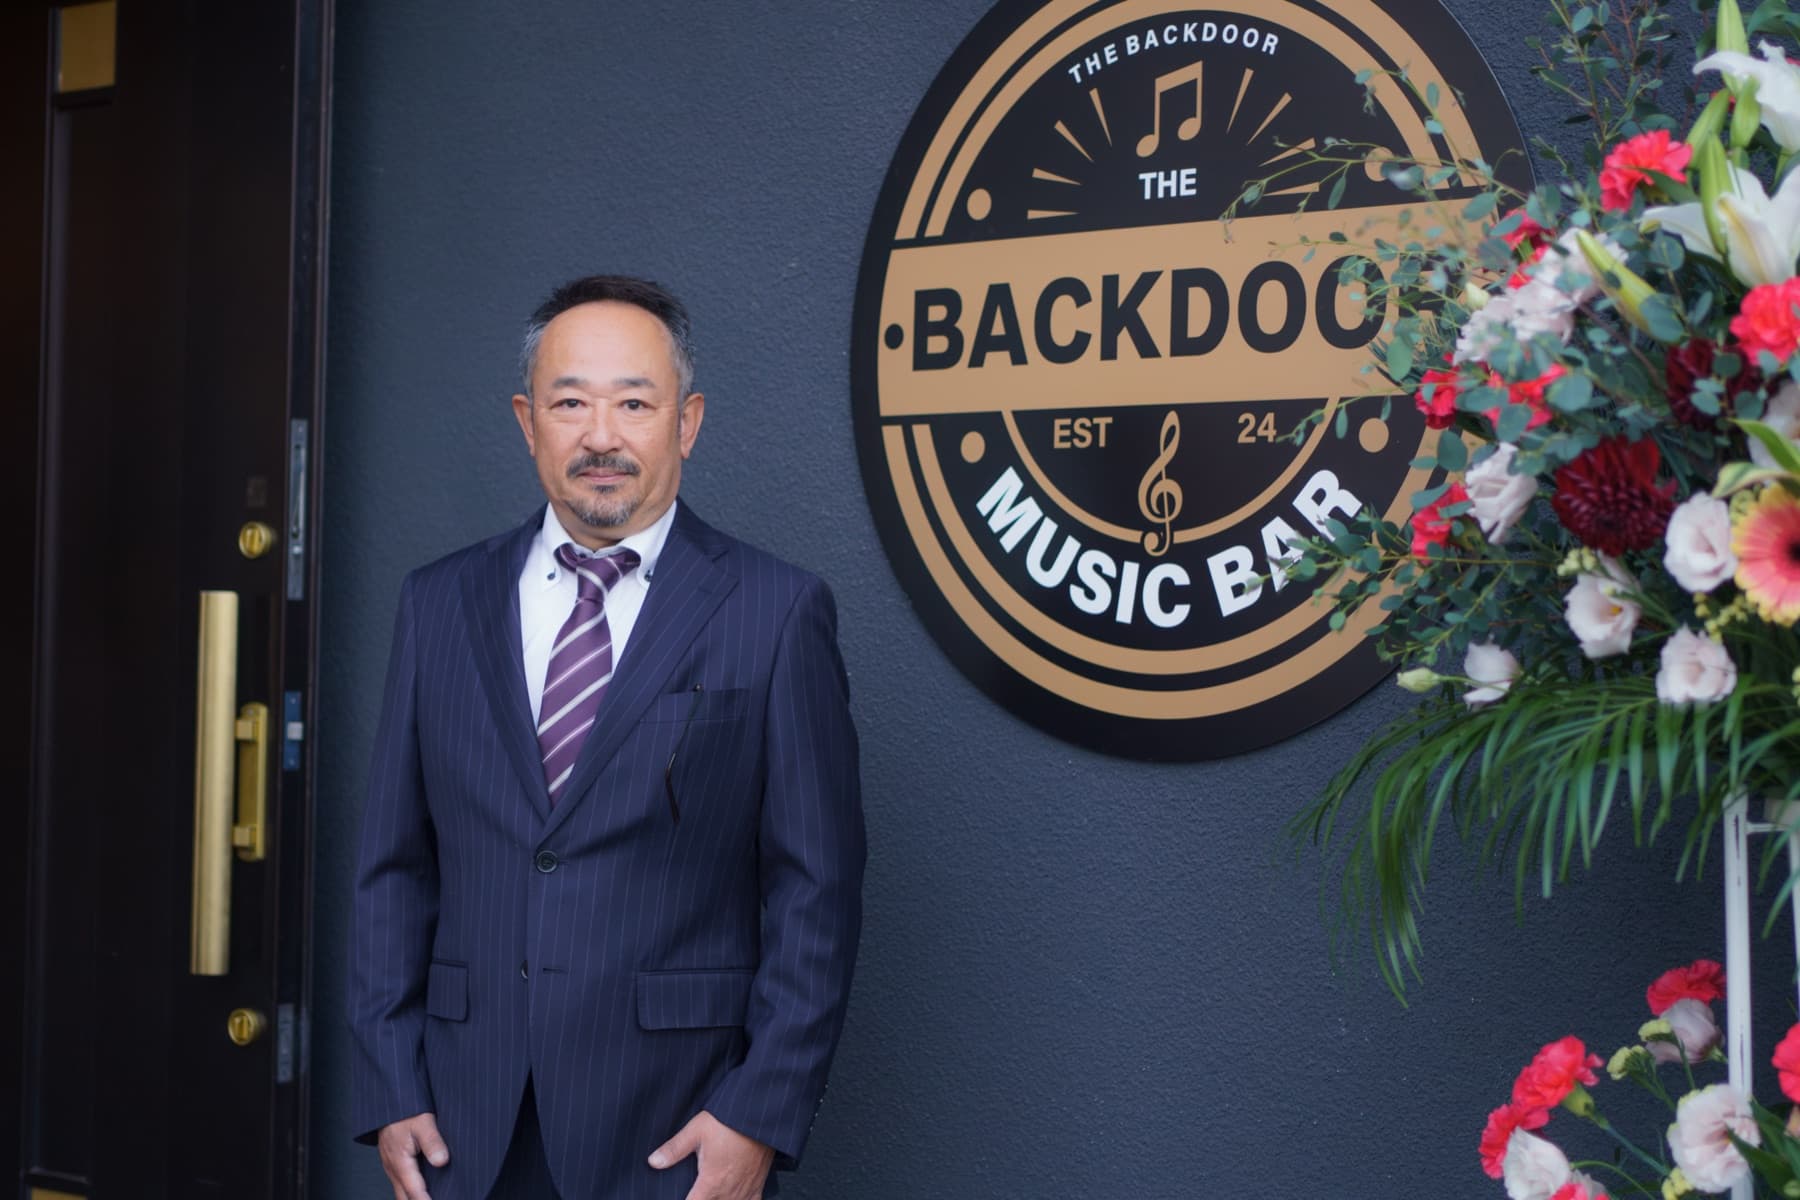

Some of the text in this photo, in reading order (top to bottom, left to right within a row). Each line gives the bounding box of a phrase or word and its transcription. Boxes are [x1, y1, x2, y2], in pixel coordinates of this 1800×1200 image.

[1068, 22, 1279, 83] THE BACKDOOR
[1139, 168, 1197, 200] THE
[1053, 413, 1277, 449] EST 24
[976, 466, 1362, 628] MUSIC BAR
